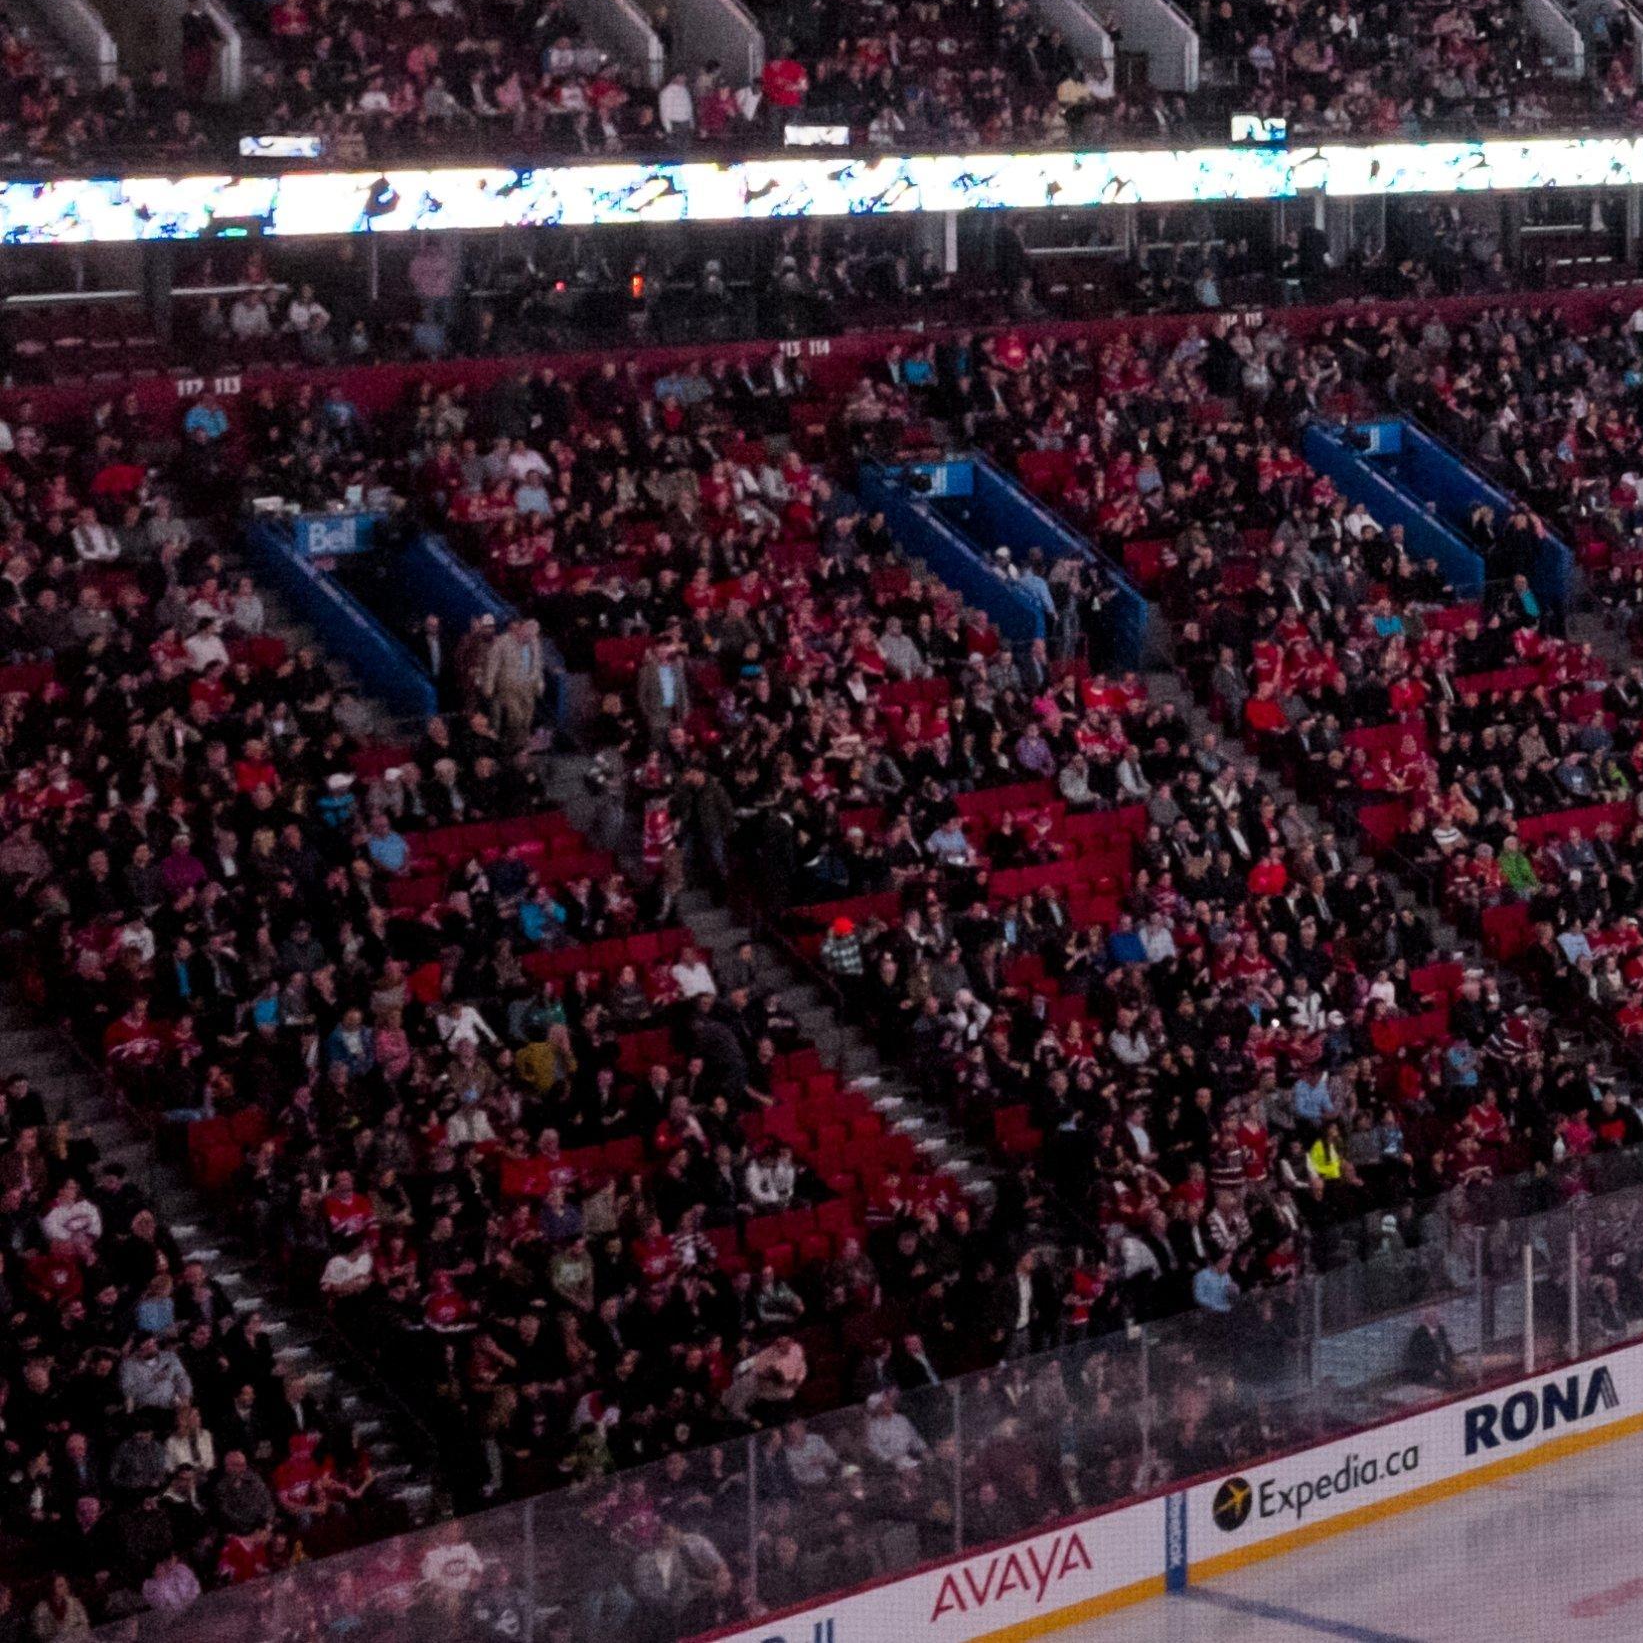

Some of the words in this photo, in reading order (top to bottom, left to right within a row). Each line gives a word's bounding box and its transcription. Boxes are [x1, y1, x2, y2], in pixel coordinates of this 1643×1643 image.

[808, 340, 830, 355] 114
[308, 519, 355, 554] Bell
[1464, 1366, 1620, 1456] RONA
[1258, 1444, 1420, 1519] Expedia.ca
[930, 1532, 1094, 1623] AVAYA
